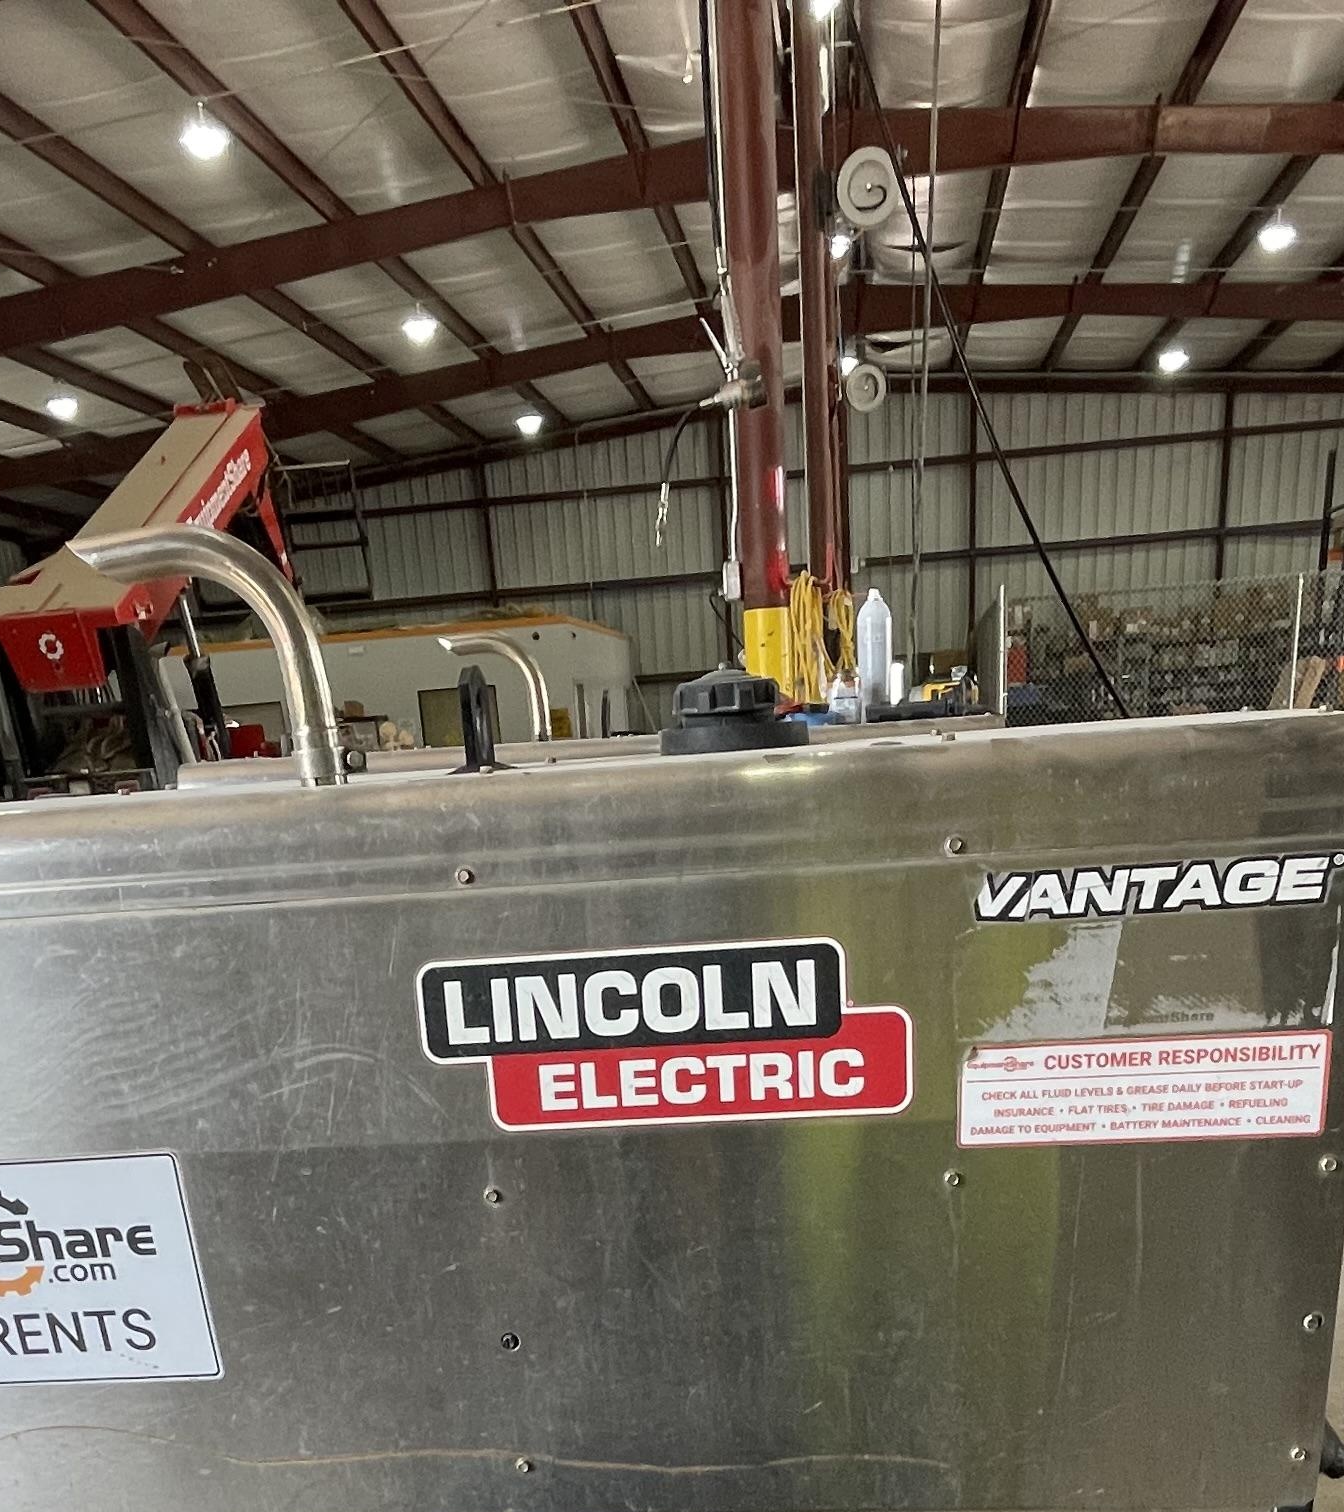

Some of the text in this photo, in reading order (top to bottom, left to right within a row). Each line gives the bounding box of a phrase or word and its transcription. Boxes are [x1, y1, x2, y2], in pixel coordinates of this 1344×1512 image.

[977, 856, 1331, 918] VANTAGE
[442, 958, 817, 1046] LINCOLN
[1044, 1050, 1152, 1070] CUSTOMER
[1158, 1043, 1321, 1065] RESPONSIBILITY
[538, 1048, 865, 1112] ELECTRIC
[982, 1090, 1017, 1101] CHECK
[1019, 1089, 1038, 1099] ALL
[1042, 1088, 1072, 1098] FLUID
[1074, 1086, 1113, 1097] LEVELS
[1127, 1083, 1169, 1096] GREASE
[1172, 1082, 1202, 1093] DAILY
[1205, 1080, 1247, 1092] BEFORE
[1249, 1079, 1303, 1090] START-UP
[994, 1097, 1288, 1118] INSURANCE FLAT TIRES TIRE DAMAGE REFUELING
[970, 1114, 1310, 1136] DAMAGE TO EQUIPMENT BATTERY MAINTENANCE CLEANING
[48, 1261, 117, 1284] .com
